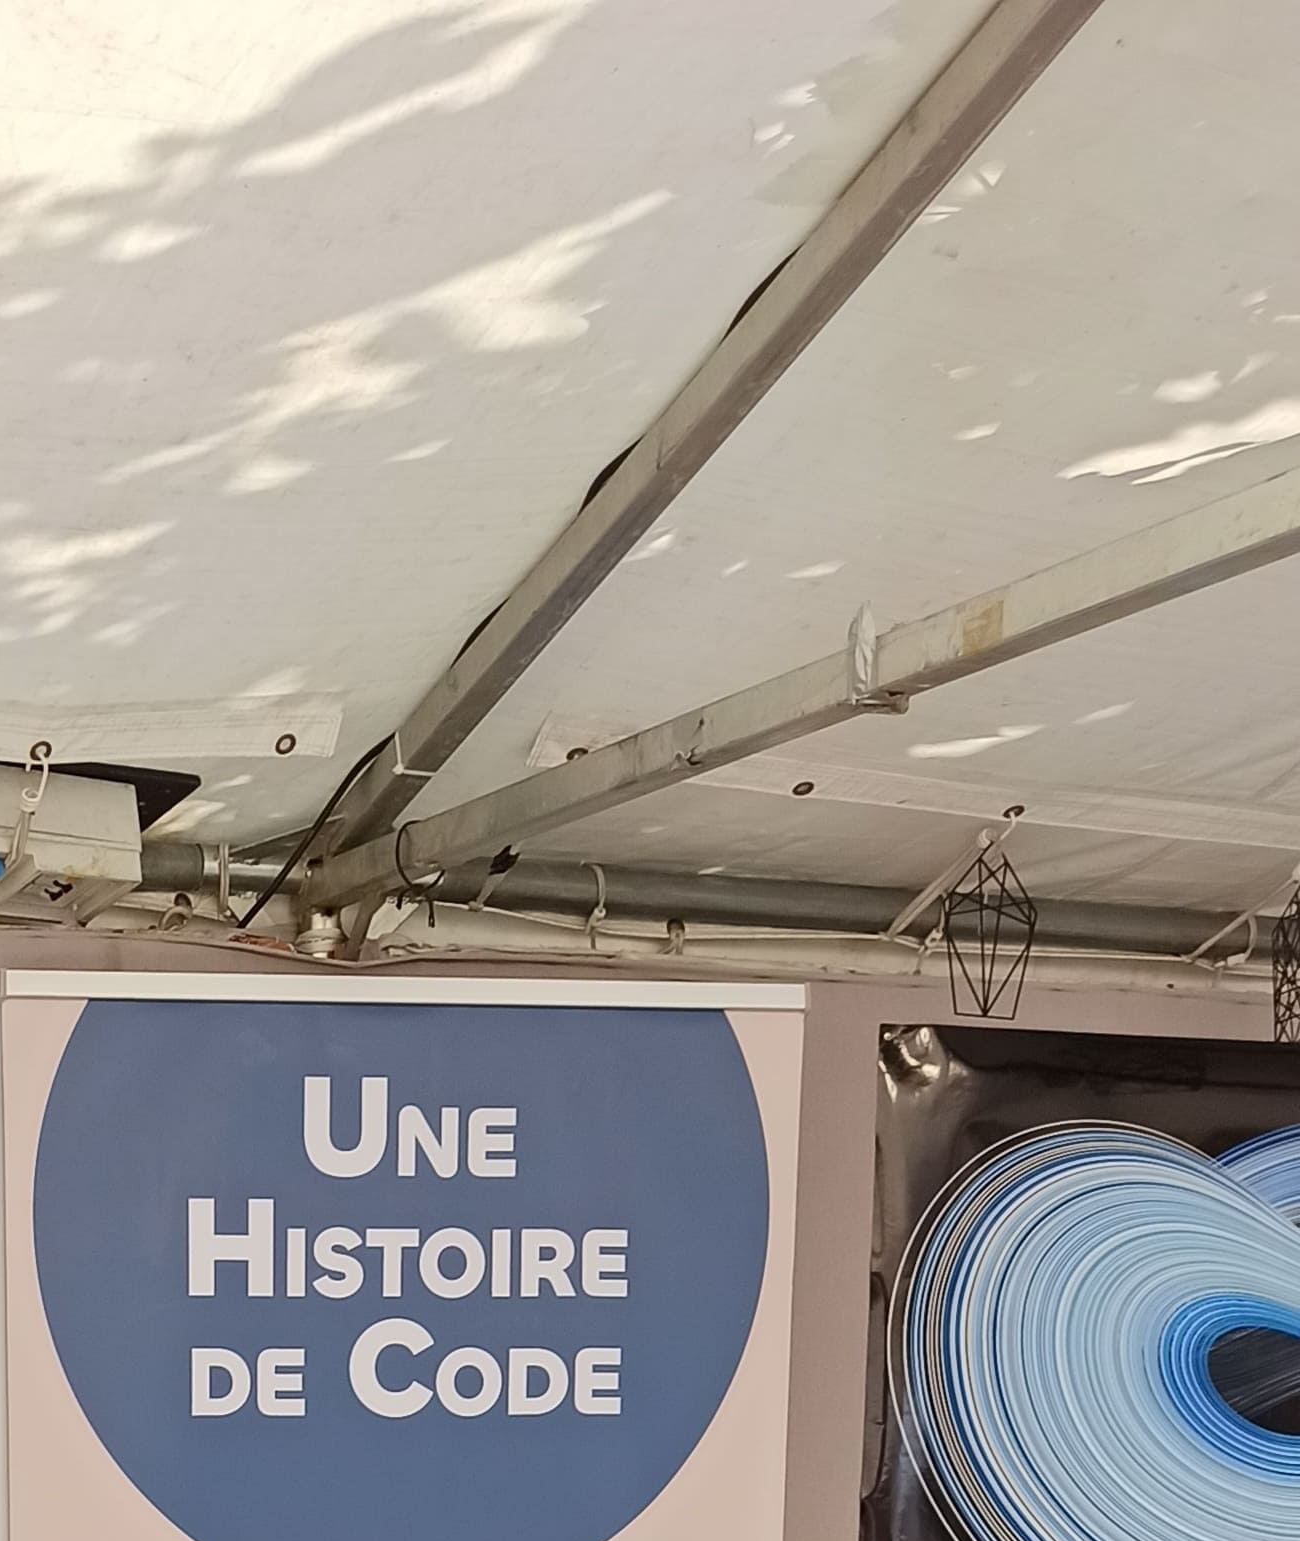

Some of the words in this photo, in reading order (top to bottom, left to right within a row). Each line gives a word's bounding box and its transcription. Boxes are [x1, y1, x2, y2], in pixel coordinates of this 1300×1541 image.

[303, 1077, 517, 1178] UNE
[188, 1198, 628, 1298] HISTOIRE
[191, 1347, 306, 1416] DE
[349, 1317, 623, 1418] CODE
